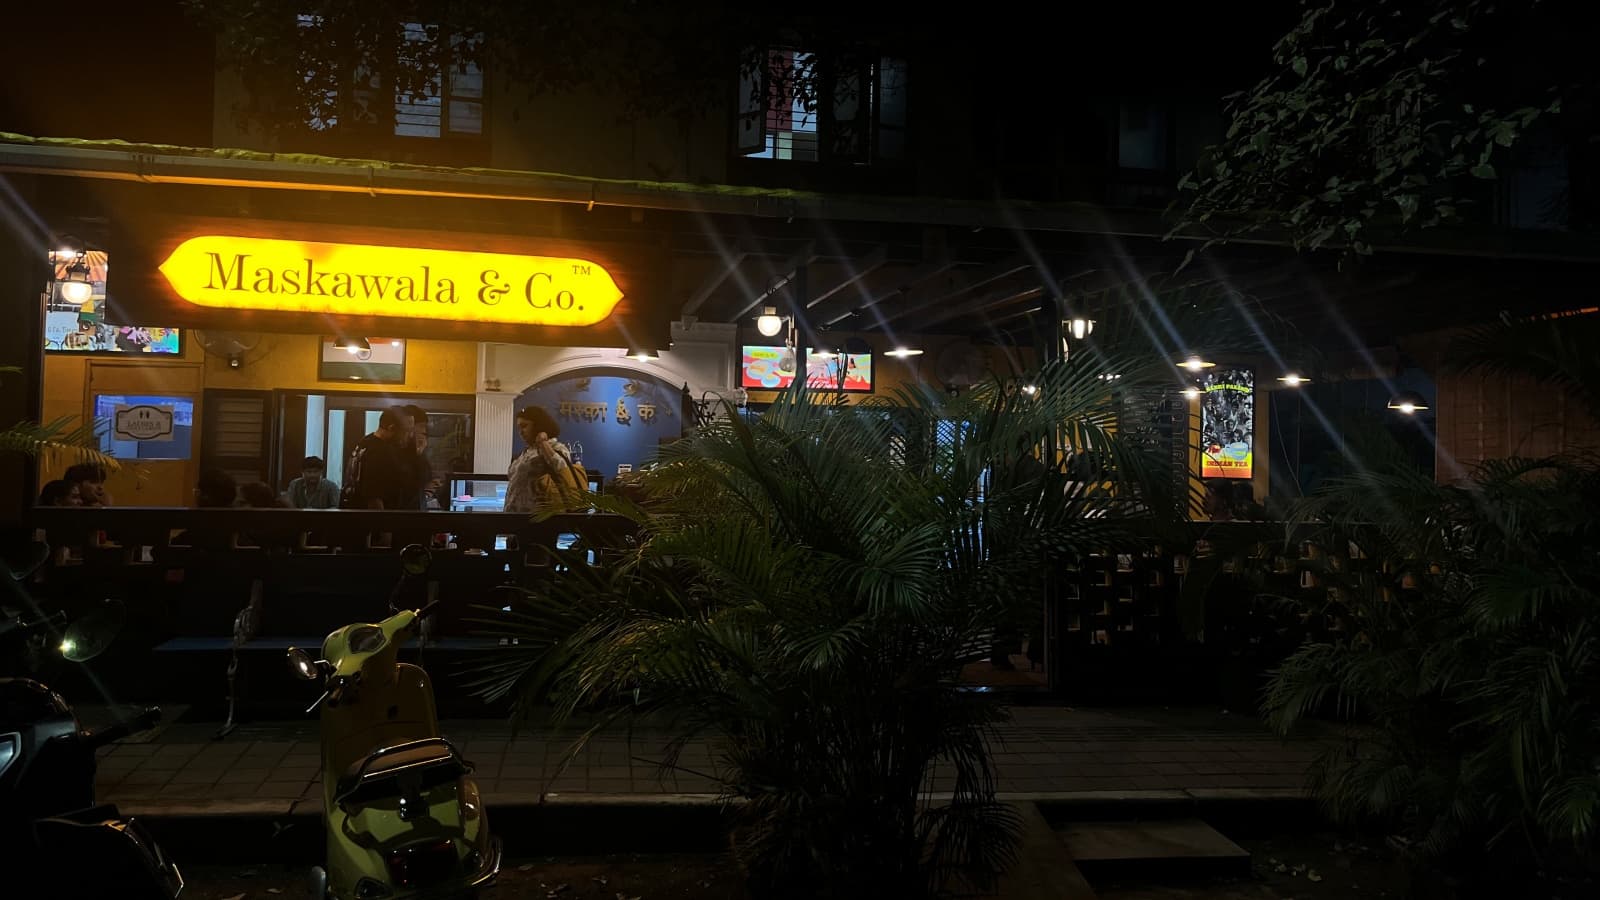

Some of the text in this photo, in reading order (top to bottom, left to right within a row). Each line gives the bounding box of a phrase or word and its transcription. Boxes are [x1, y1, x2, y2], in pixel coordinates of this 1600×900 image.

[202, 251, 460, 304] Maskawala
[477, 269, 511, 306] &
[524, 272, 585, 311] Co.
